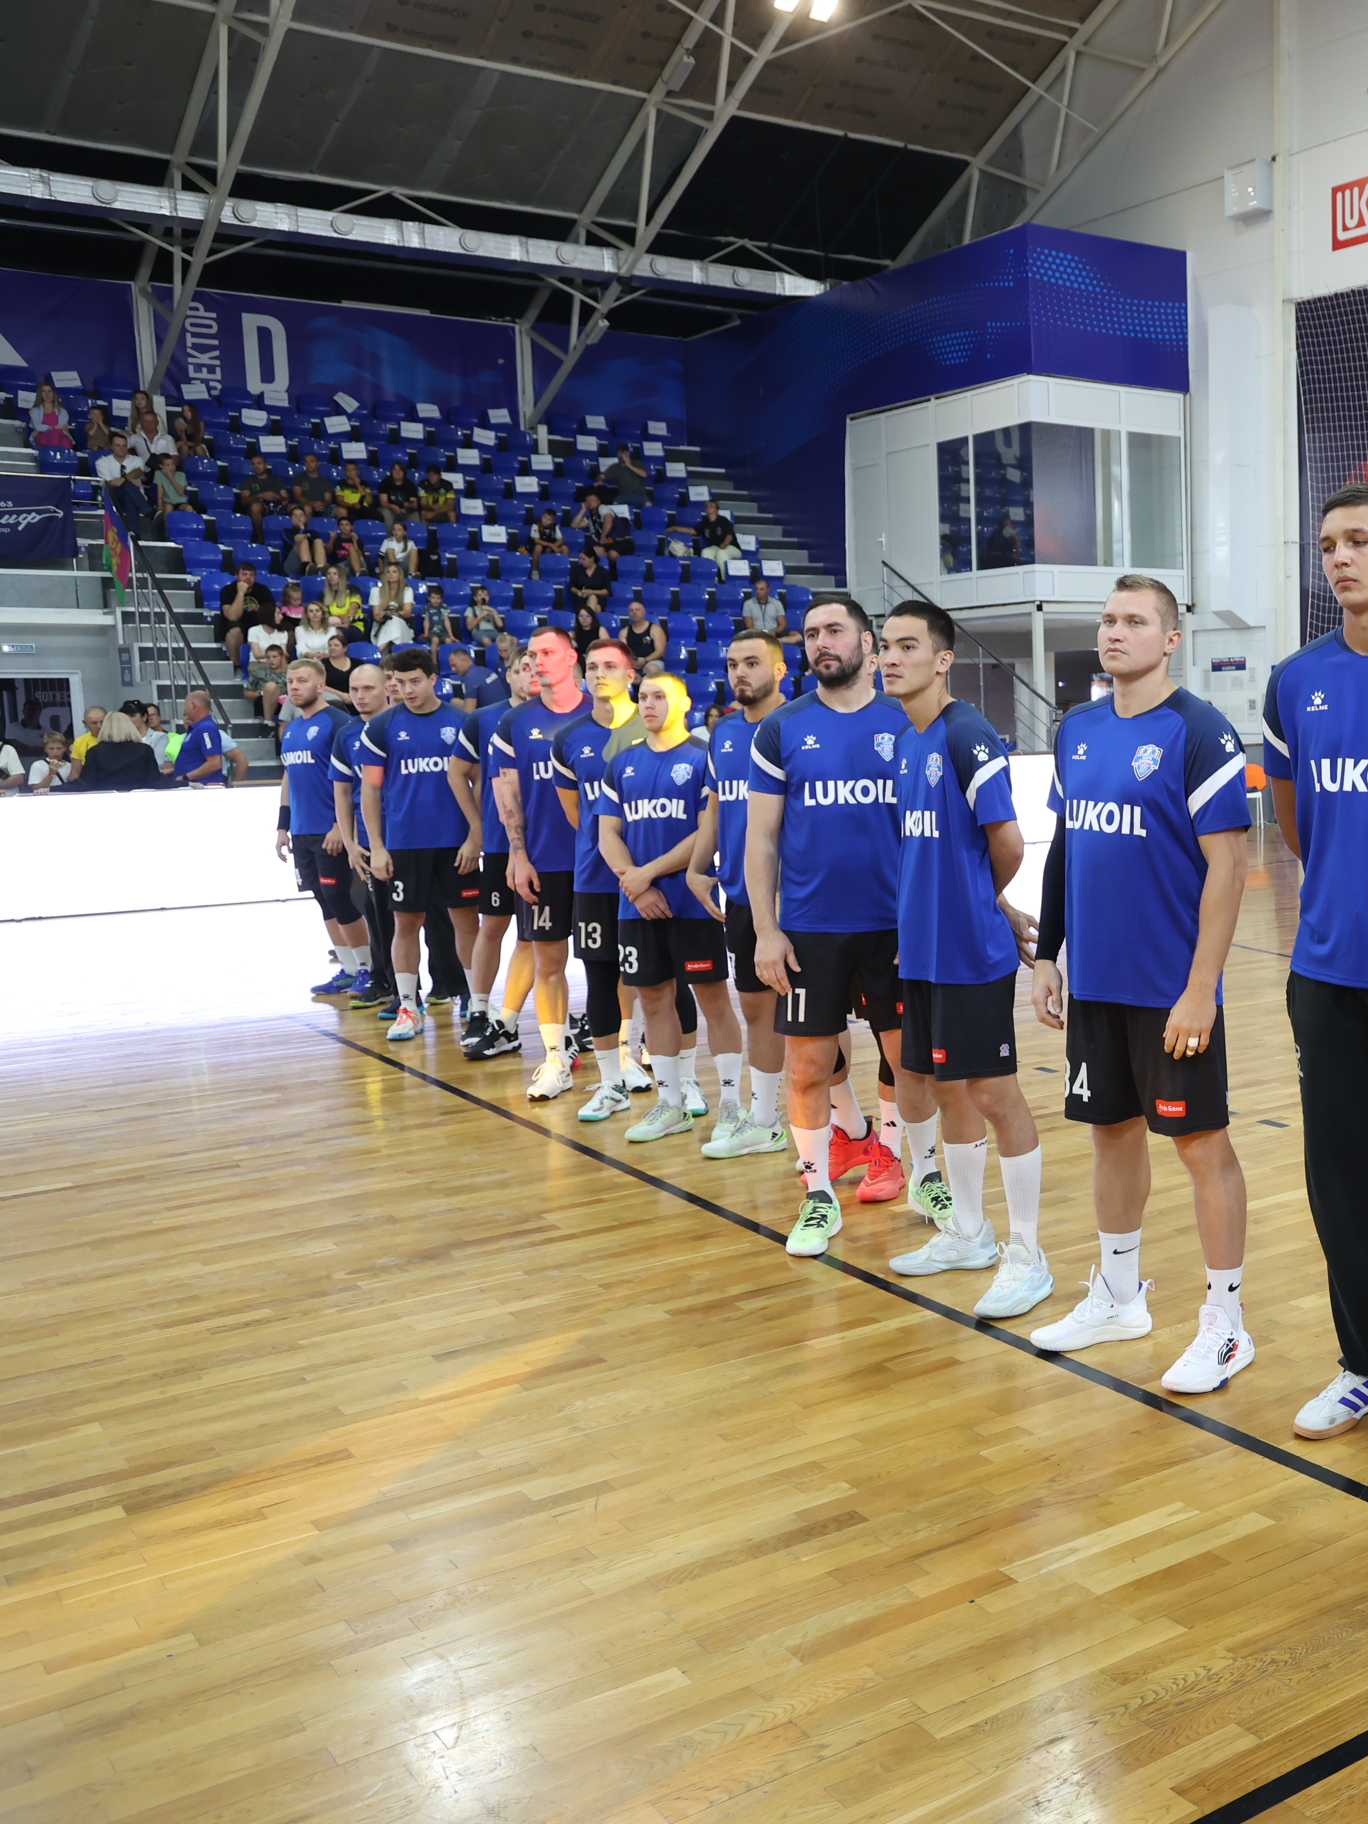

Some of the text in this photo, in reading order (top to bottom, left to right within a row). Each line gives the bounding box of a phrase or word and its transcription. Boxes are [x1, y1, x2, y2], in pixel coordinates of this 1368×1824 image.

[241, 312, 290, 395] D
[1306, 704, 1329, 712] KELME
[401, 757, 451, 774] LUKOI
[718, 780, 749, 801] LUK
[804, 779, 897, 806] LUKOIL
[623, 798, 687, 822] LUKOIL
[1065, 799, 1147, 837] LUKOIL
[903, 809, 940, 838] KOIL
[392, 881, 404, 902] 3
[491, 892, 500, 907] 6
[531, 905, 552, 931] 14
[578, 921, 602, 949] 13
